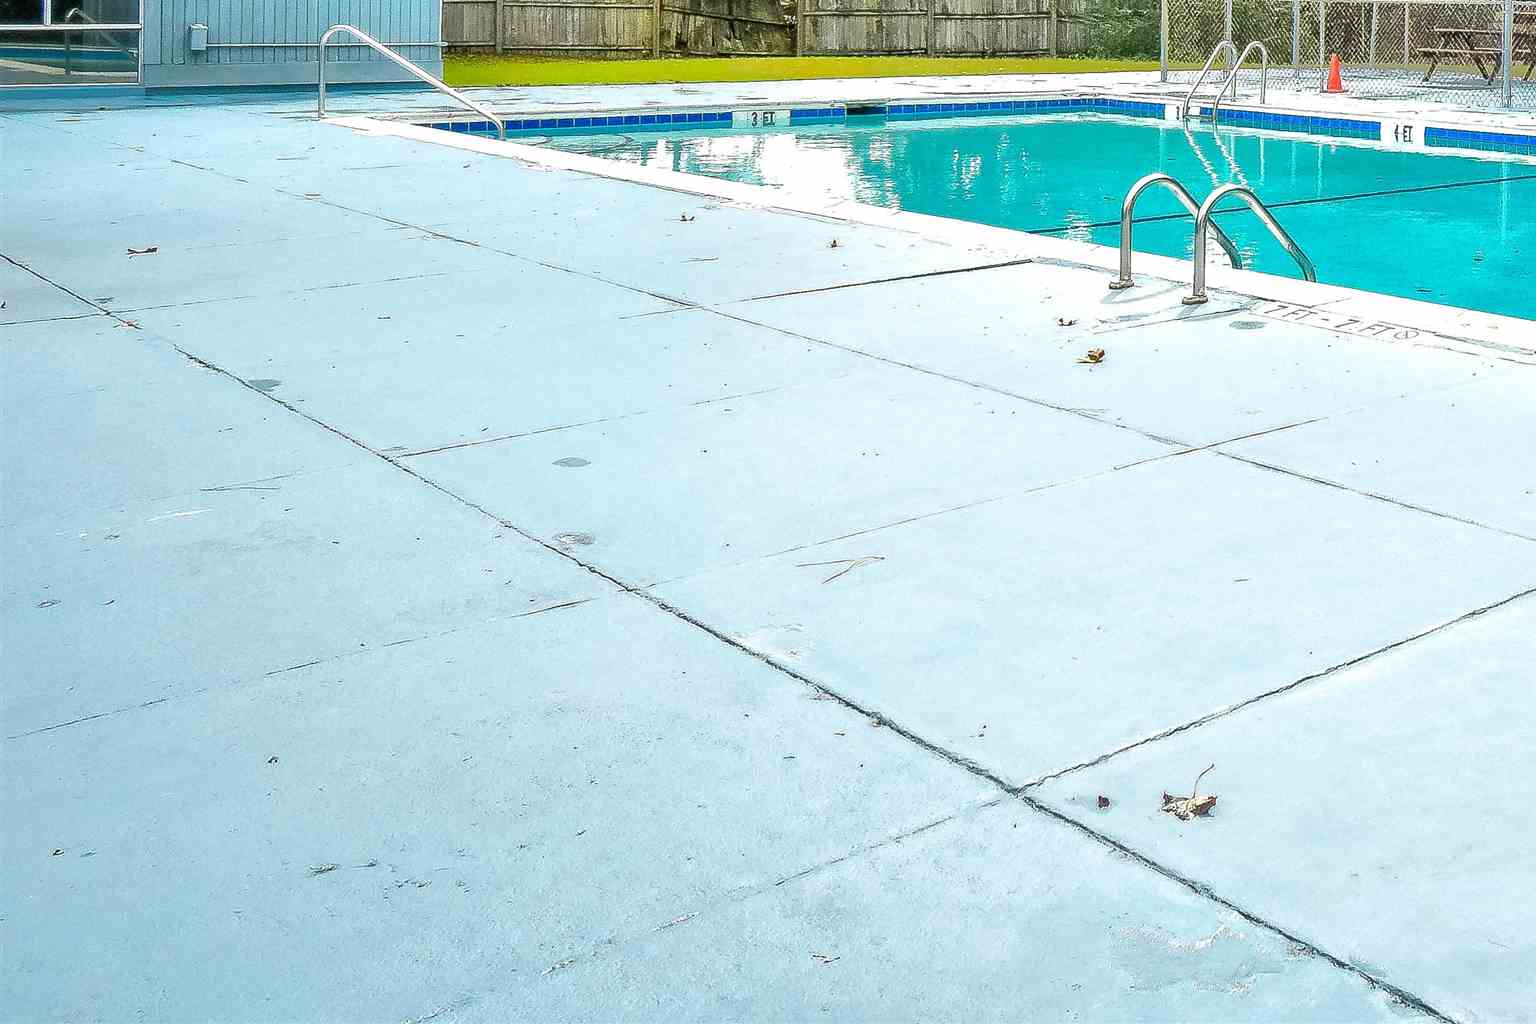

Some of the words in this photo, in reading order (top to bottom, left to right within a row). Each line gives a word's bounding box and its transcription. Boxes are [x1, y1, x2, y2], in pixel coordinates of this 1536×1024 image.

[1264, 305, 1289, 314] 7
[1282, 309, 1319, 321] FT
[1357, 323, 1396, 336] FT
